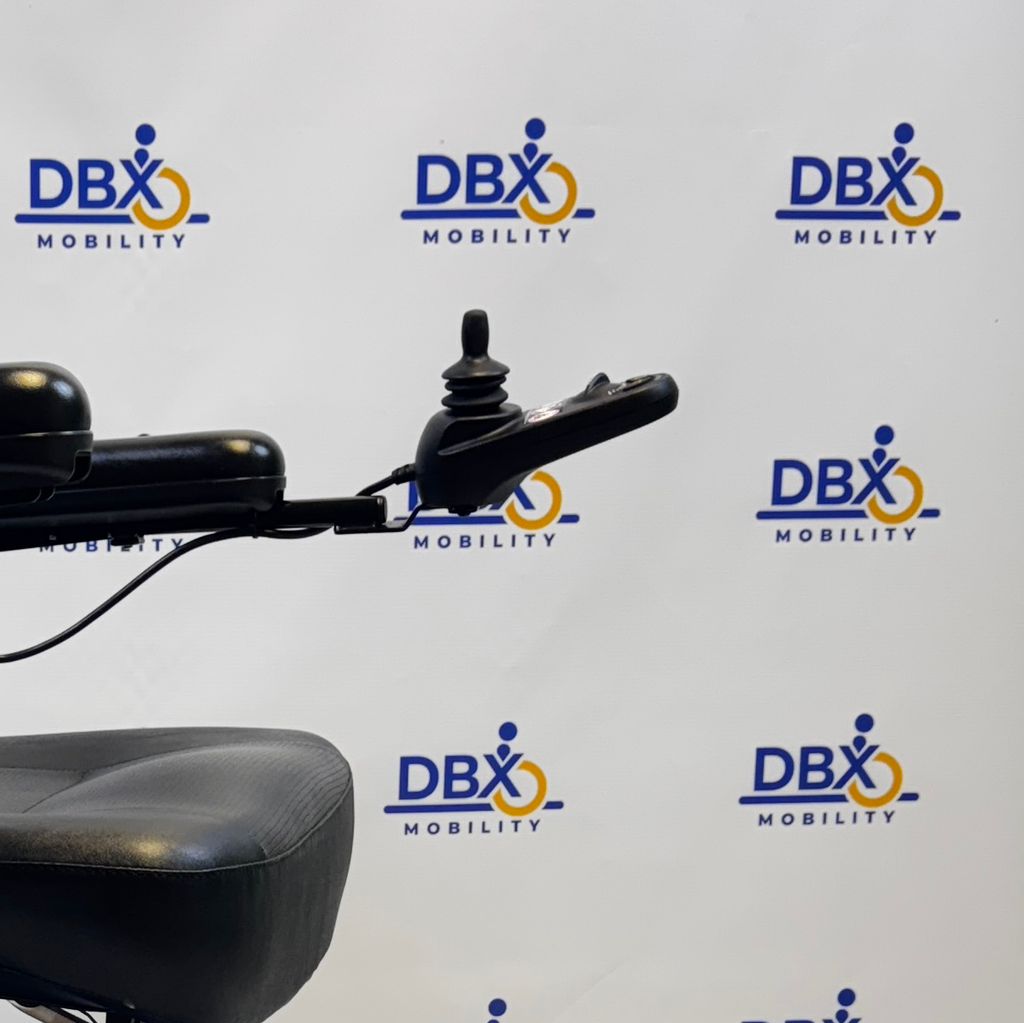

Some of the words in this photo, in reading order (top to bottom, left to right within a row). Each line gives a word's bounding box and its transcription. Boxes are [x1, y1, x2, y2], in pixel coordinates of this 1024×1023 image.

[29, 158, 164, 209] DBX
[416, 153, 552, 205] DBX
[790, 156, 921, 206] DBX
[38, 234, 186, 249] MOBILITY
[422, 228, 571, 244] MOBILITY
[794, 229, 937, 244] MOBILITY
[771, 458, 901, 506] DBX
[413, 533, 556, 549] MOBILITY
[775, 527, 916, 543] MOBILITY
[753, 743, 880, 791] DBX
[398, 753, 523, 800] DBX
[404, 818, 542, 835] MOBILITY
[758, 810, 895, 827] MOBILITY
